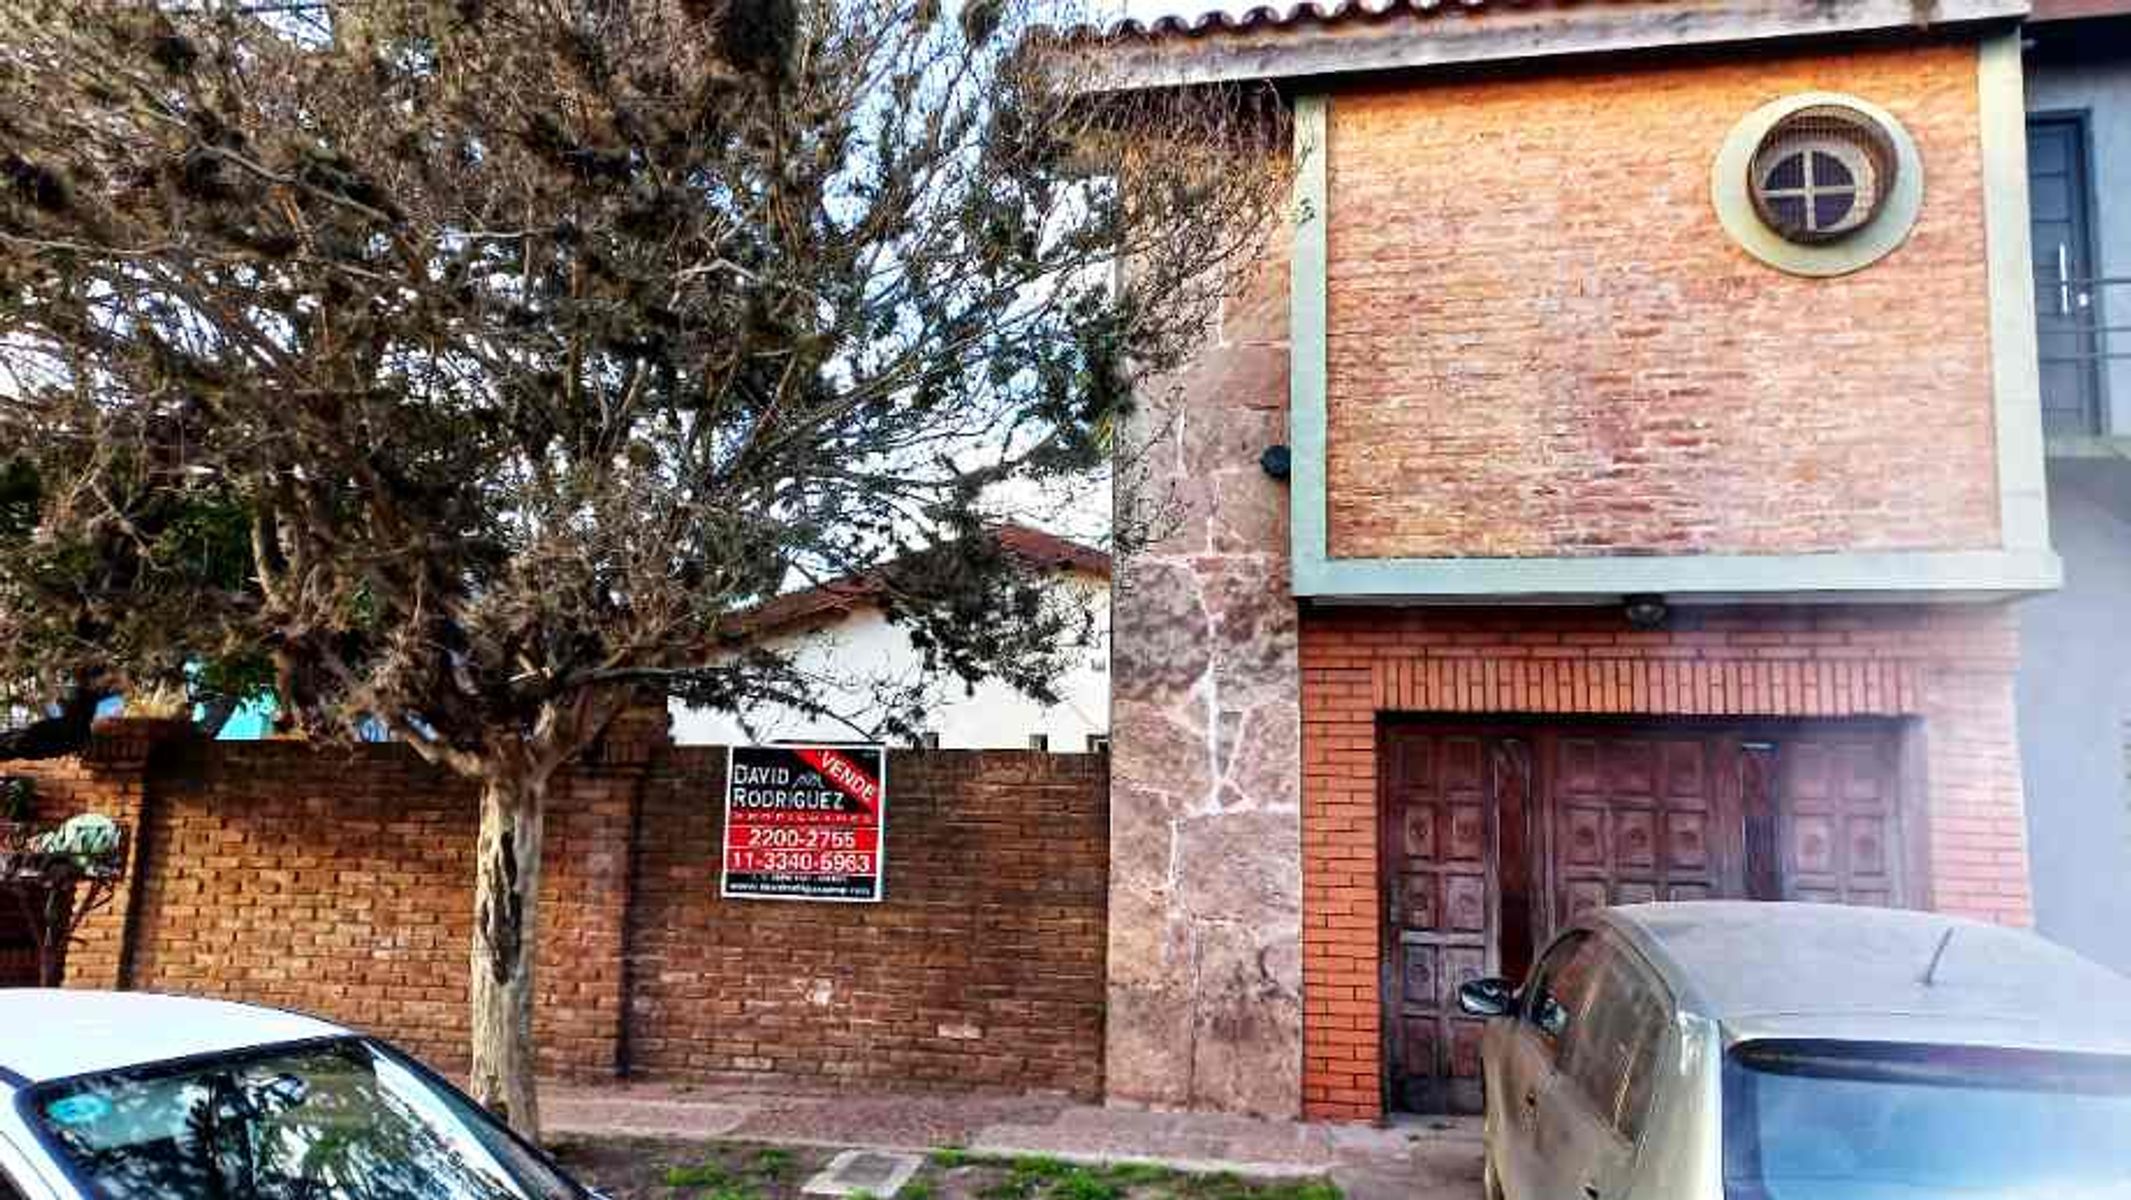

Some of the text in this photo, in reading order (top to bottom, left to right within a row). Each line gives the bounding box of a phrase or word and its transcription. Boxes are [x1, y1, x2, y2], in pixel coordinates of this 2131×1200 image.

[733, 764, 789, 785] DAVID
[821, 751, 874, 801] VENDE
[733, 788, 845, 810] RODRIGUEZ
[750, 829, 856, 849] 2200-2755
